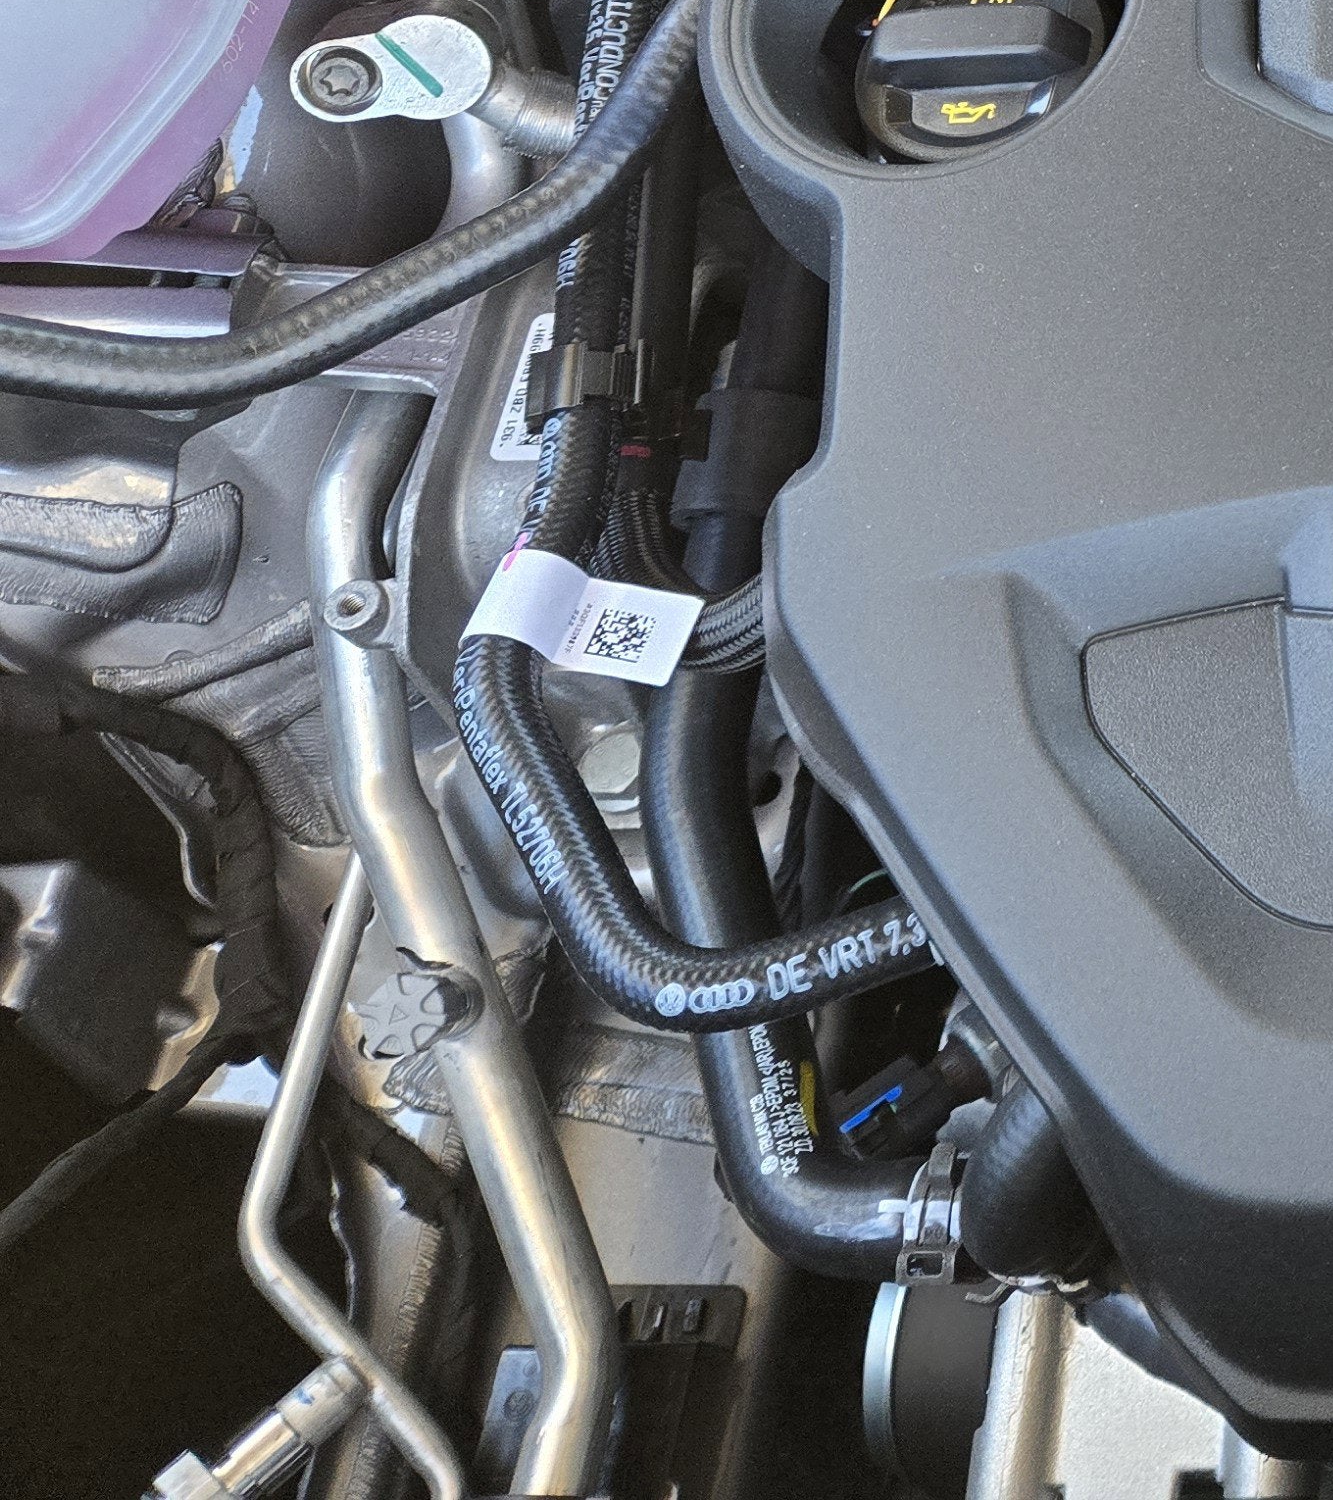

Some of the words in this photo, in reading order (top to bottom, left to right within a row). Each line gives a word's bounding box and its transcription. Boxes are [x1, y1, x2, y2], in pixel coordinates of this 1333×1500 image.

[498, 779, 568, 897] TL52706H
[765, 954, 813, 1001] DE
[819, 928, 877, 980] VRT
